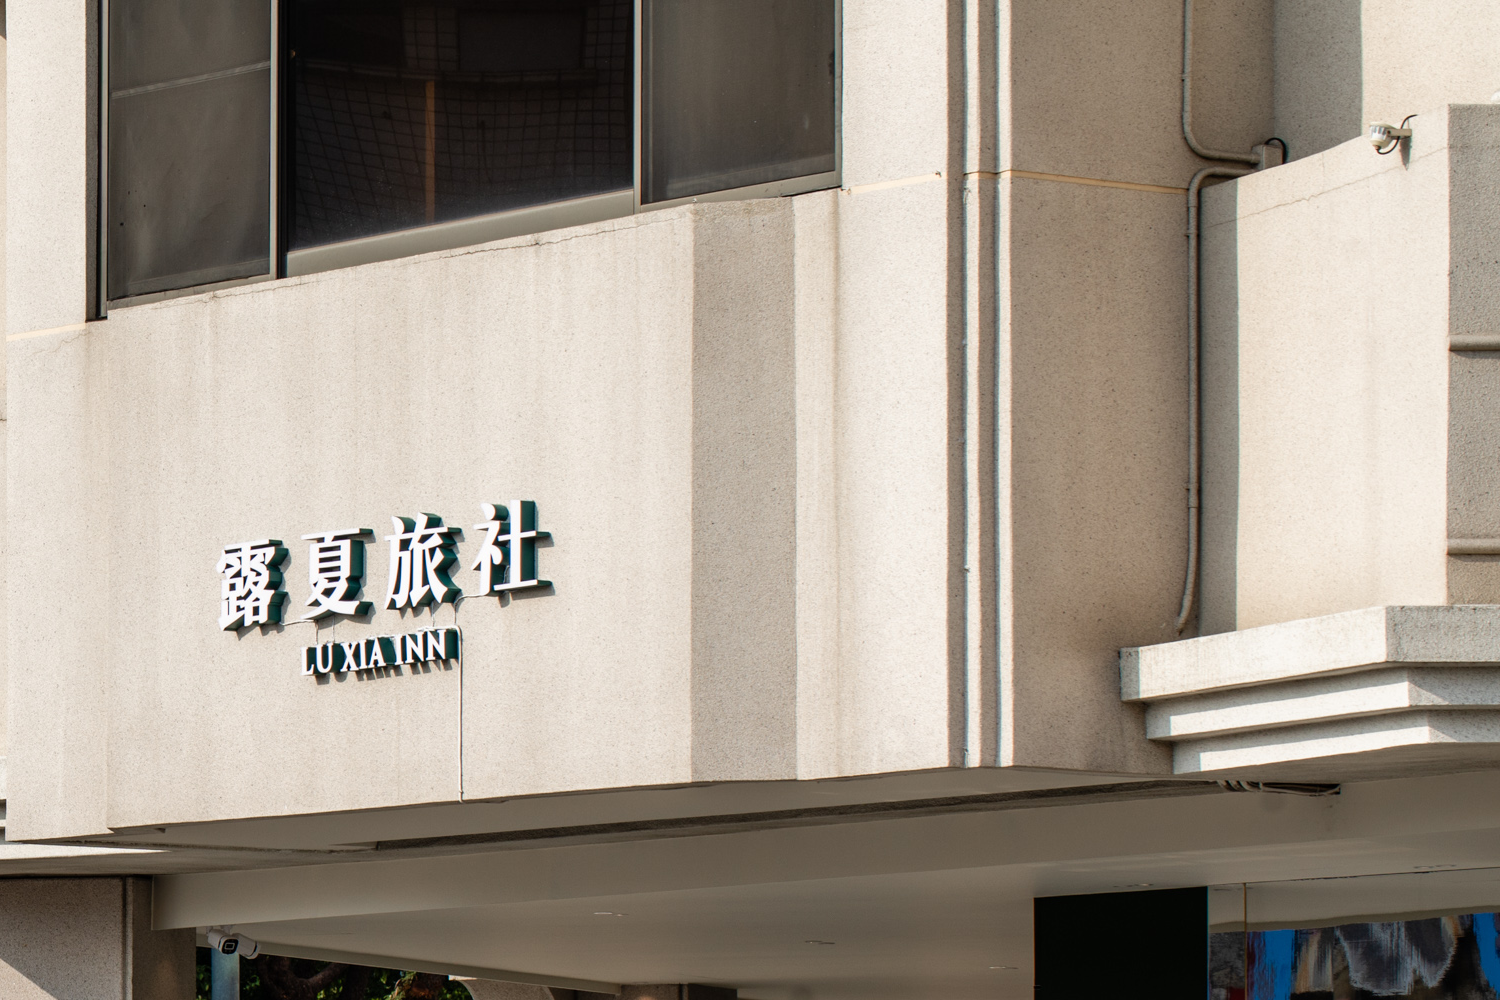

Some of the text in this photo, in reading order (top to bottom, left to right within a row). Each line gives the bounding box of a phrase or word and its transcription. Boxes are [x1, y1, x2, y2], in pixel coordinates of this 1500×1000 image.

[216, 499, 550, 633] 露夏旅社
[394, 629, 453, 666] INN
